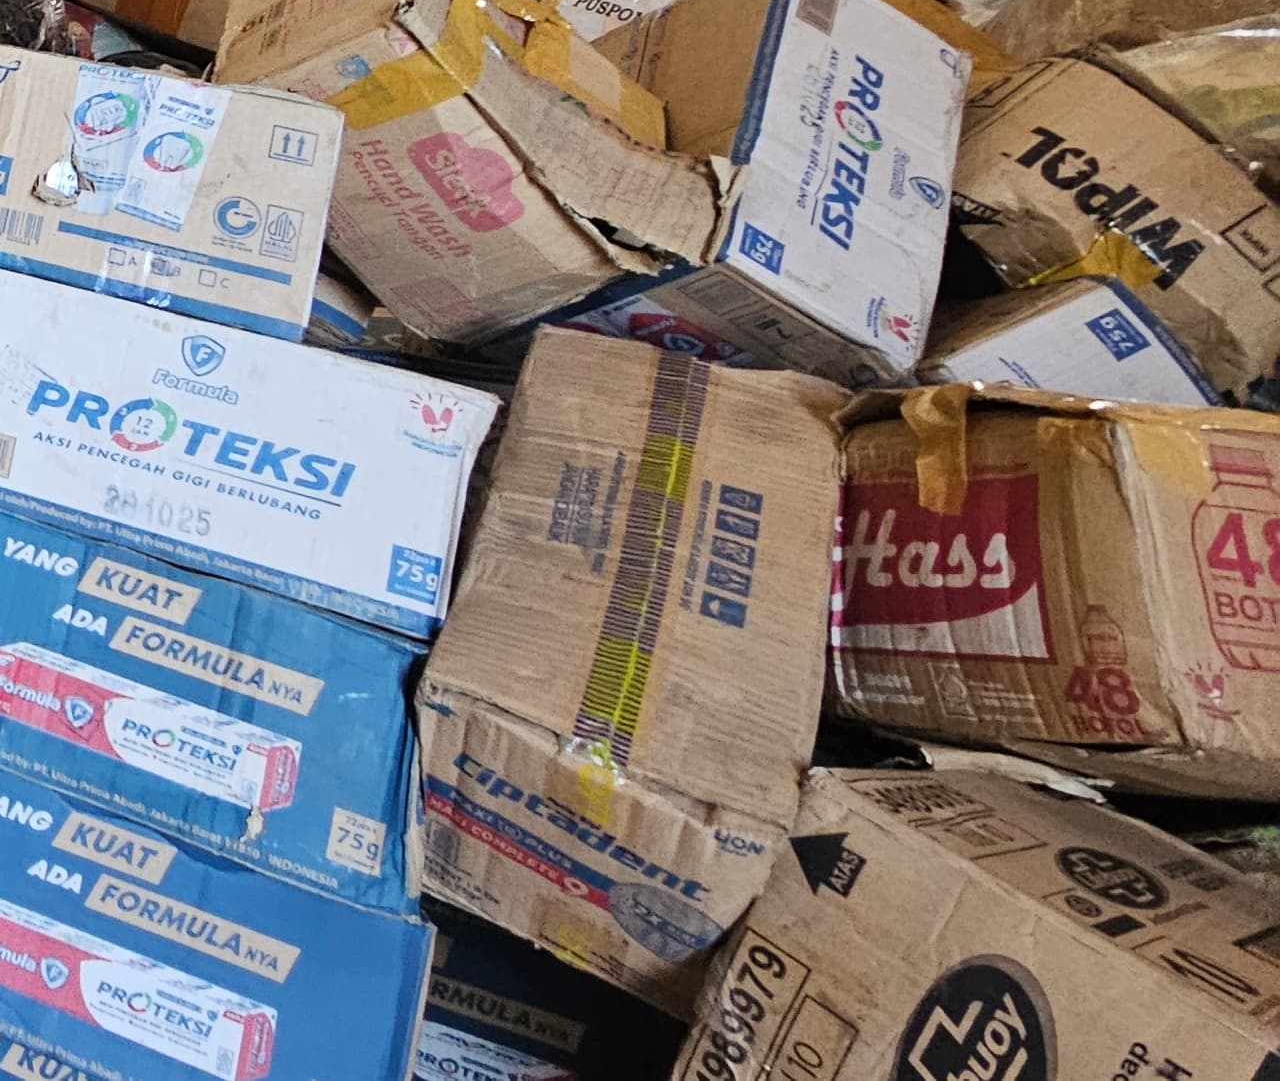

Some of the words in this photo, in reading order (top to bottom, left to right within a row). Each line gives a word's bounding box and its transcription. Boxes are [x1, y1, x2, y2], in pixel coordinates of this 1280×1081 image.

[819, 54, 886, 252] PROTEKSI
[360, 138, 426, 200] Hand
[408, 202, 472, 259] Wash
[1016, 125, 1205, 290] WIPOL
[151, 367, 239, 406] Formula
[27, 379, 358, 499] PROTEKSI
[32, 430, 74, 450] AKSI
[77, 442, 167, 477] PENCEGAH
[172, 468, 210, 489] GIGI
[215, 480, 322, 520] BERLUBANG
[2, 537, 79, 579] YANG
[394, 560, 438, 592] 75g
[95, 568, 184, 610] KUAT
[1213, 592, 1280, 622] BOT
[51, 602, 108, 637] ADA
[125, 625, 265, 694] FORMULA
[267, 675, 305, 706] NYA
[1064, 666, 1141, 716] 48
[121, 717, 238, 773] PROTEKSI
[71, 823, 160, 872] KUAT
[337, 827, 379, 859] 75g
[452, 751, 712, 903] Ciptadent
[26, 859, 84, 895] ADA
[98, 885, 242, 957] FORMULA
[243, 944, 279, 973] NYA
[96, 980, 211, 1038] PROTEKSI
[430, 981, 532, 1030] RMULA
